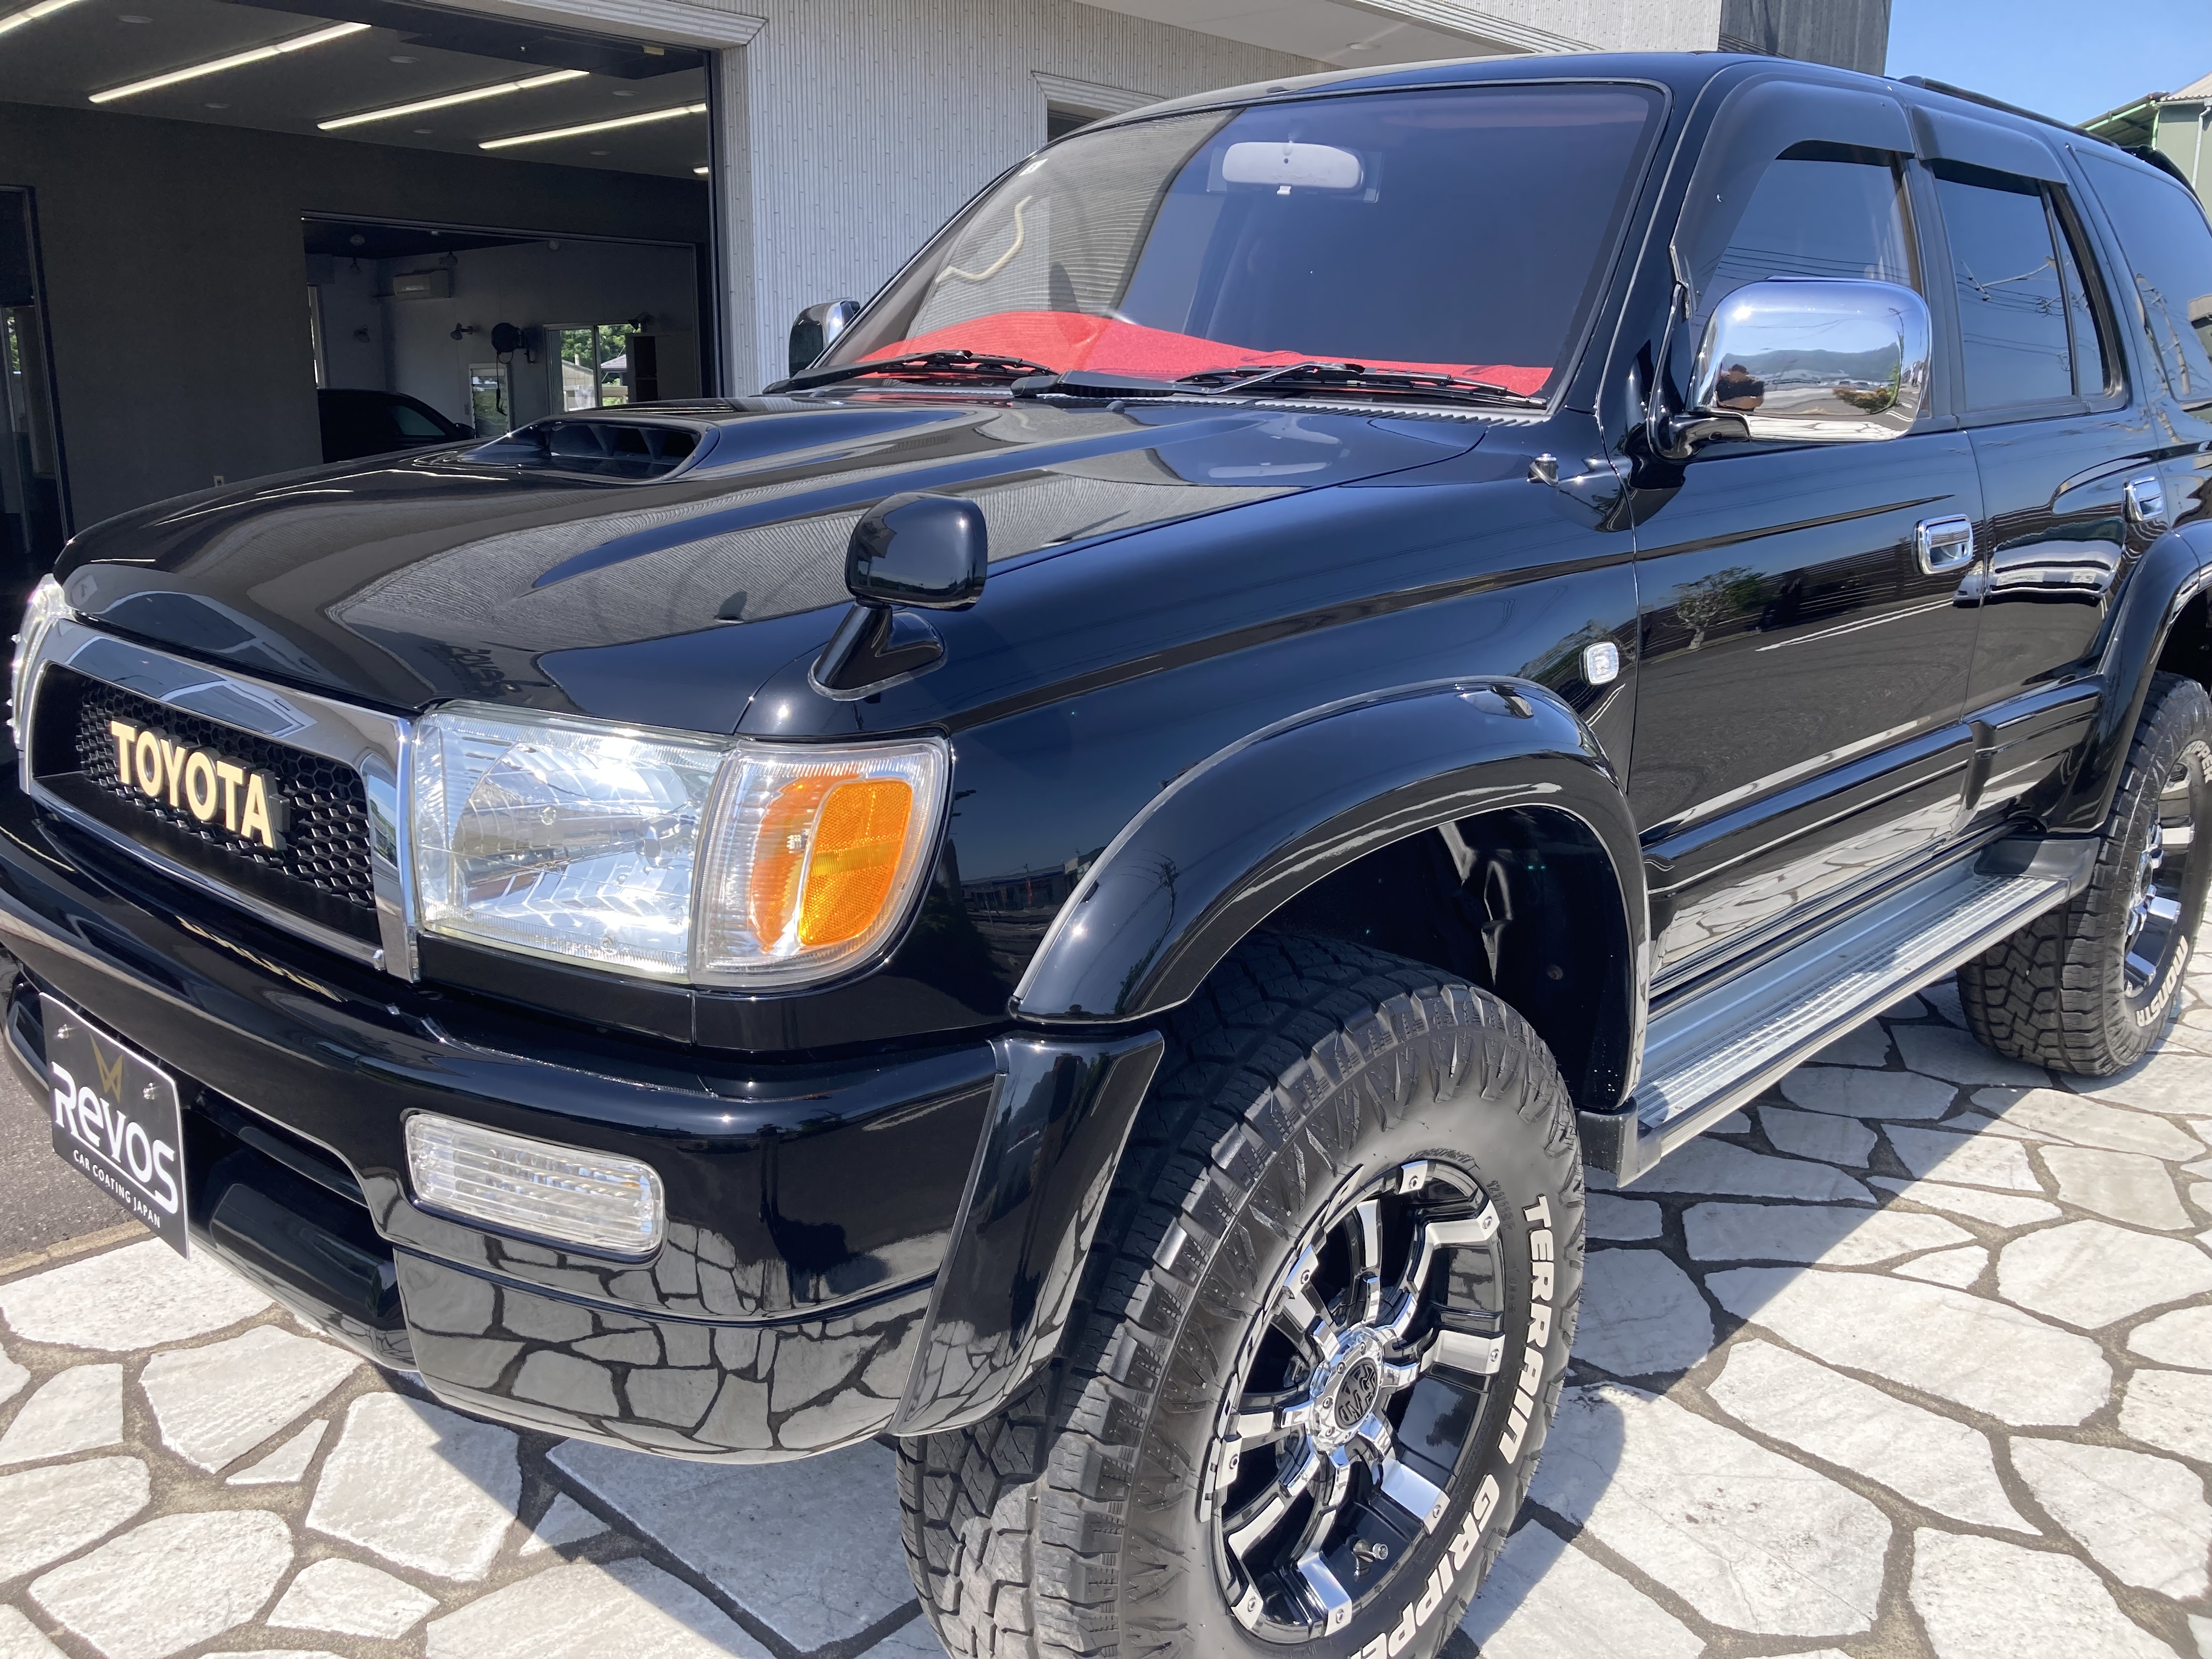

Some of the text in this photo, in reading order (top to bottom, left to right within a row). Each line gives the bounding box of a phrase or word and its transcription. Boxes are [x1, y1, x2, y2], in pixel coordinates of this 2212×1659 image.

[111, 720, 274, 849] TOYOTA
[73, 1149, 161, 1228] CAR COATING JAPAN
[1350, 1195, 1554, 1659] TERRAIN GRIPPE
